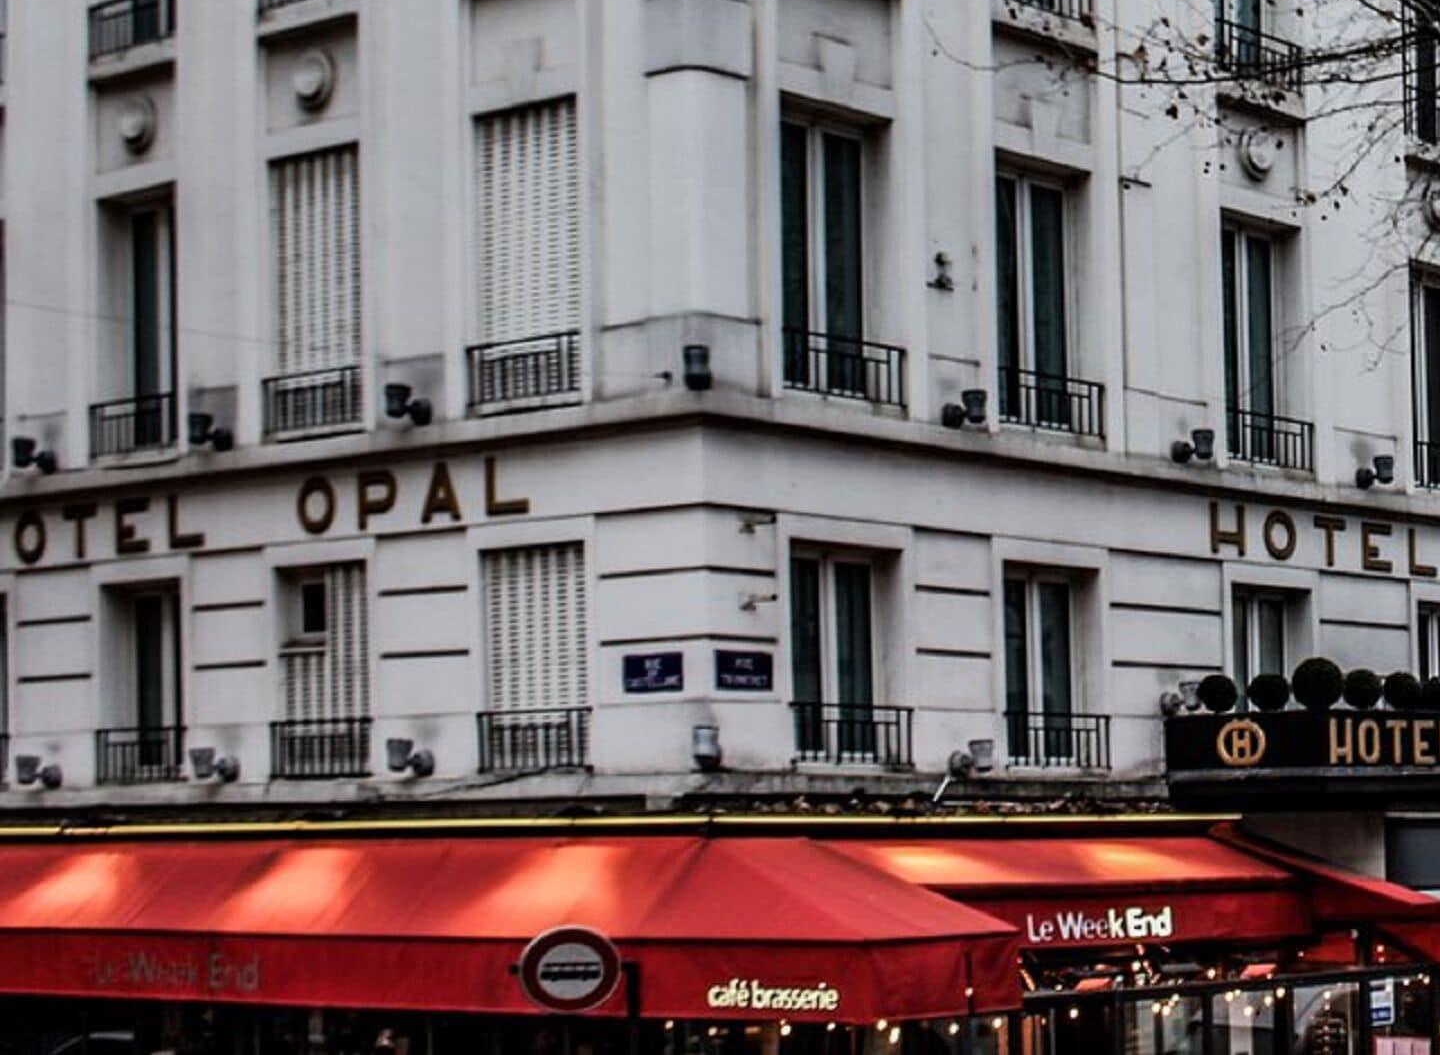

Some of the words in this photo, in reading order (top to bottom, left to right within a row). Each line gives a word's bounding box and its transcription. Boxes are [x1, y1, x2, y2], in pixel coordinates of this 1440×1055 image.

[14, 495, 204, 565] OTEL
[298, 456, 530, 534] OPAL
[1209, 500, 1437, 578] HOTEL
[1027, 914, 1052, 942] Le
[707, 978, 750, 1007] café
[751, 979, 838, 1010] brasserie
